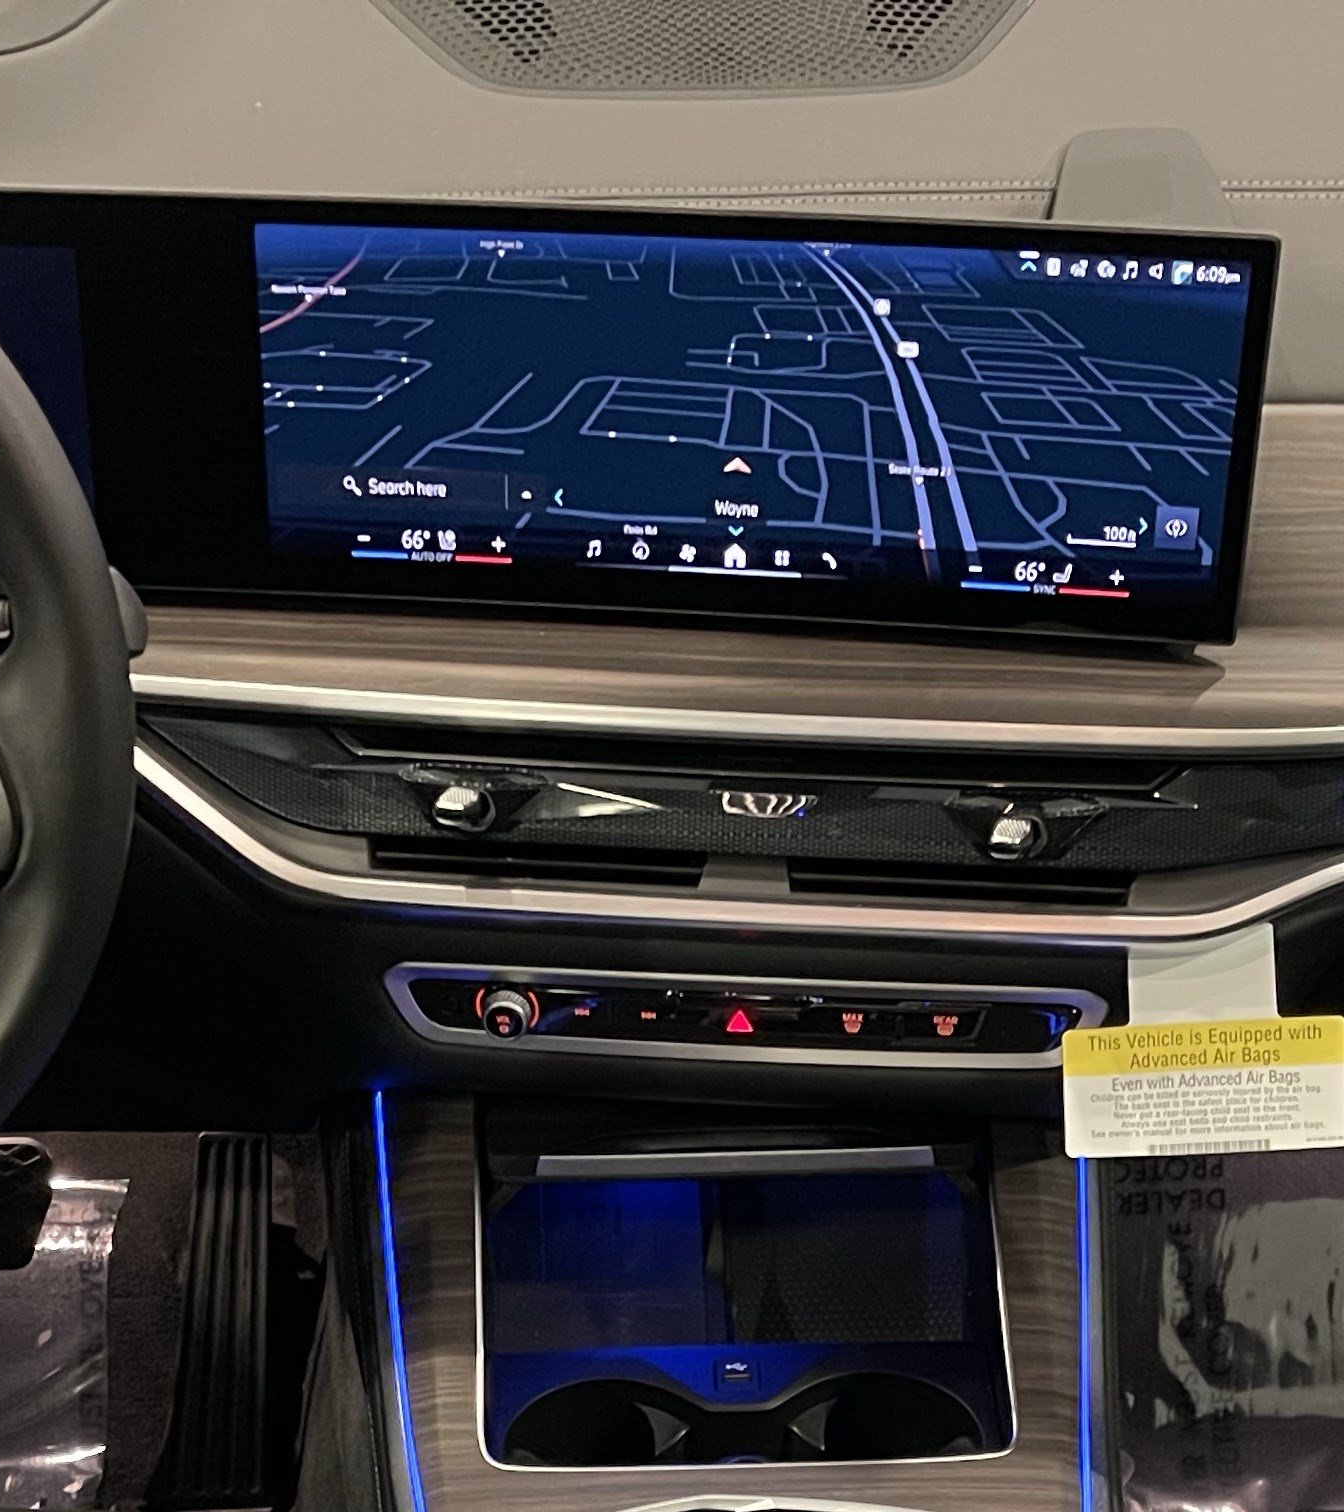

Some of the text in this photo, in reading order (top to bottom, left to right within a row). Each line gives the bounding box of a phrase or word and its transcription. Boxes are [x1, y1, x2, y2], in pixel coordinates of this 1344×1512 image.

[368, 477, 447, 498] Search here
[714, 499, 759, 519] Wayne
[411, 551, 453, 562] AUTO OFF
[933, 1015, 958, 1025] REAR
[1087, 1034, 1121, 1052] This
[1126, 1030, 1183, 1050] Vehicle
[1208, 1025, 1282, 1046] Equipped
[1288, 1023, 1322, 1041] with
[1130, 1046, 1281, 1070] Advanced Air Bags
[1111, 1069, 1301, 1093] Even with Advanced Air Bags
[1127, 1093, 1141, 1101] can
[1144, 1092, 1154, 1100] be
[1157, 1090, 1179, 1099] killed
[1276, 1085, 1289, 1093] the
[1292, 1085, 1303, 1093] air
[1115, 1100, 1129, 1110] The
[1132, 1101, 1151, 1110] back
[1153, 1101, 1170, 1109] seat
[1182, 1099, 1196, 1107] the
[1226, 1096, 1247, 1106] place
[1249, 1095, 1261, 1104] for
[1113, 1111, 1137, 1119] Never
[1139, 1111, 1153, 1120] put
[1163, 1109, 1208, 1118] rear-facing
[1210, 1105, 1230, 1115] child
[1233, 1105, 1250, 1114] seat
[1263, 1103, 1276, 1112] the
[1091, 1130, 1106, 1138] See
[1108, 1129, 1140, 1138] owner's
[1143, 1128, 1173, 1137] manual
[1175, 1127, 1187, 1135] for
[1213, 1124, 1262, 1133] information
[1264, 1122, 1288, 1131] about
[1290, 1121, 1301, 1129] air
[1120, 1120, 1150, 1129] Always
[1169, 1118, 1187, 1126] seat
[1212, 1116, 1227, 1124] and
[1229, 1114, 1250, 1123] child
[1116, 1188, 1226, 1215] DEALER
